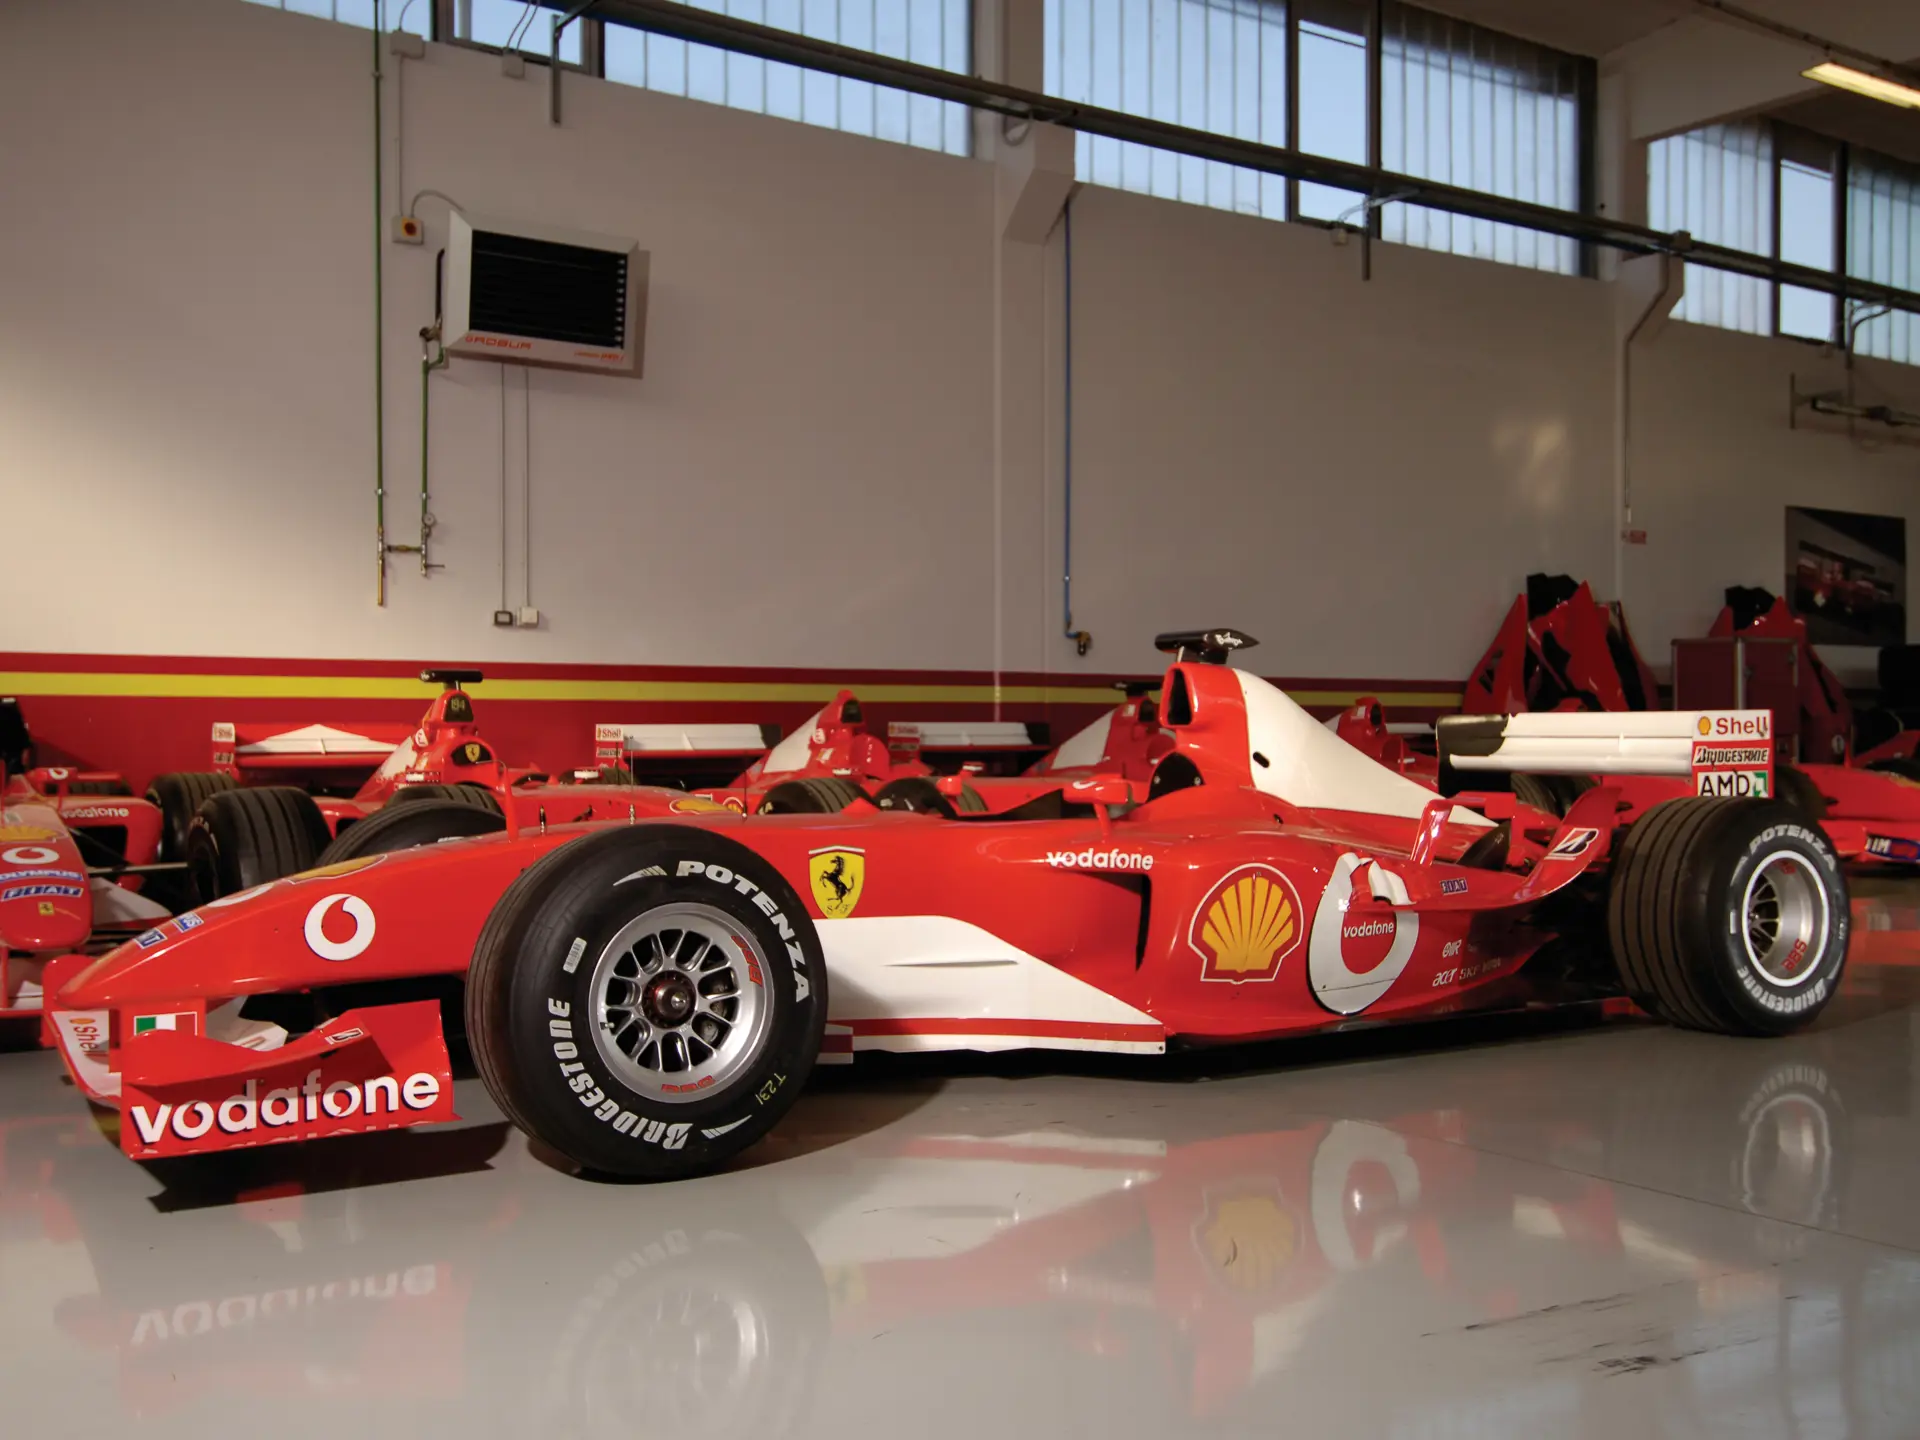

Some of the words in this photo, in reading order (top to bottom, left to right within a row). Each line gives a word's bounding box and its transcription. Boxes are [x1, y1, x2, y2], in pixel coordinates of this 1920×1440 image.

[1716, 715, 1768, 736] Shell
[1701, 774, 1750, 796] AMD
[1046, 847, 1154, 871] vodafone
[1750, 824, 1834, 870] POTENZA
[3, 884, 83, 900] FIAT
[1441, 879, 1467, 894] FIAT
[676, 860, 810, 1002] POTENZA
[1343, 920, 1395, 938] vodafone
[1781, 938, 1807, 972] BBS
[1737, 965, 1826, 1013] BRIDGESTONE
[548, 997, 694, 1150] BRIDGESTONE
[131, 1069, 440, 1143] vodafone
